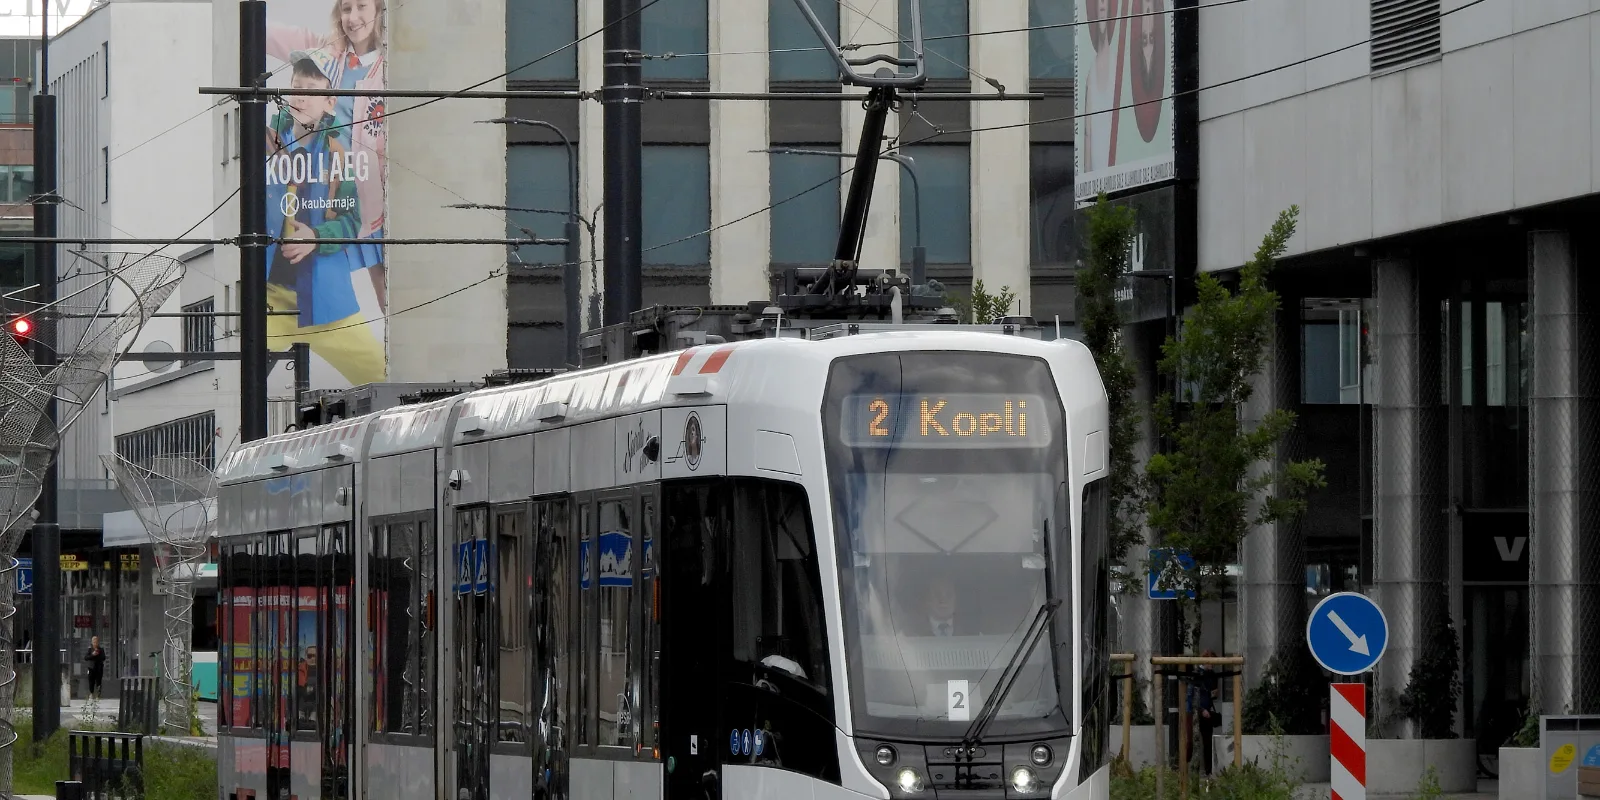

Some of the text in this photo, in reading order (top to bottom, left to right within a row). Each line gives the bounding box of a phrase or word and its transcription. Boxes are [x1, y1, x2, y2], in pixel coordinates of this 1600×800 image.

[266, 151, 369, 185] KOOLI AEG
[302, 196, 356, 211] kaubamaja
[869, 400, 1027, 436] 2 Kopli
[951, 691, 965, 709] 2
